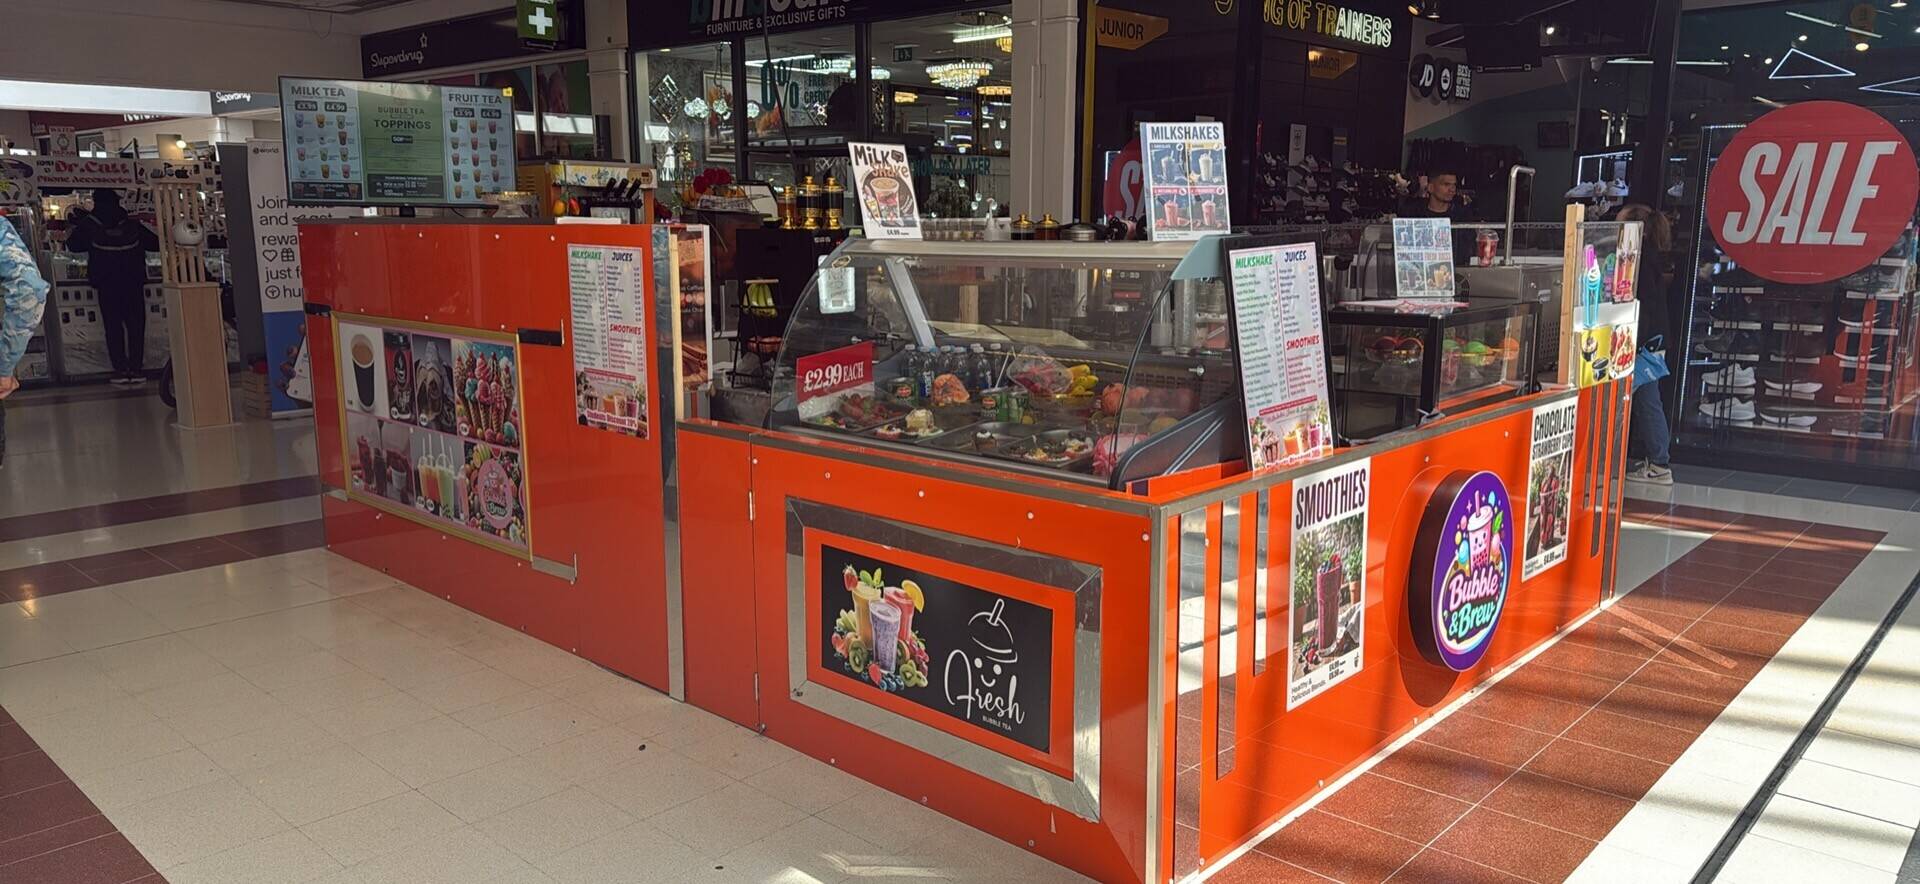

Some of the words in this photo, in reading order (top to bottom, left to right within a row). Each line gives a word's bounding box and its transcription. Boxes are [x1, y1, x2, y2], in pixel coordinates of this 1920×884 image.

[706, 19, 754, 35] FURNITURE
[756, 17, 763, 28] &
[765, 10, 816, 27] EXCLUSIVE
[818, 5, 846, 20] GIFTS
[1287, 0, 1312, 29] OF
[1316, 2, 1392, 48] TRAINERS
[1100, 18, 1144, 40] JUNIOR
[371, 50, 424, 68] Superdrug
[1420, 64, 1434, 87] JD
[1457, 64, 1472, 77] BEST
[291, 86, 319, 95] MILK
[322, 88, 345, 96] TEA
[449, 94, 479, 102] FRUIT
[1455, 85, 1470, 98] BEST
[374, 119, 432, 129] TOPPINGS
[1151, 126, 1220, 140] MILKSHAKES
[1722, 141, 1899, 246] SALE
[260, 212, 288, 226] and
[571, 250, 602, 260] MILKSHAKE
[612, 252, 633, 262] JUICES
[1235, 254, 1273, 268] MILKSHAKE
[1284, 250, 1307, 263] JUICES
[265, 266, 292, 283] just
[283, 285, 303, 299] hu
[610, 323, 642, 336] SMOOTHIES
[1286, 335, 1320, 351] SMOOTHIES
[803, 363, 843, 393] £2.99
[843, 361, 864, 383] EACH
[1534, 404, 1576, 442] CHOCOLATE
[1532, 436, 1562, 461] STRAWBERRY
[1562, 432, 1574, 450] CUPS
[1296, 468, 1367, 530] SMOOTHIES
[1449, 567, 1499, 611] Bubble
[1457, 603, 1496, 638] Brew
[944, 649, 1025, 724] Fresh
[982, 715, 1001, 728] BUBBLE
[1002, 721, 1012, 732] TEA
